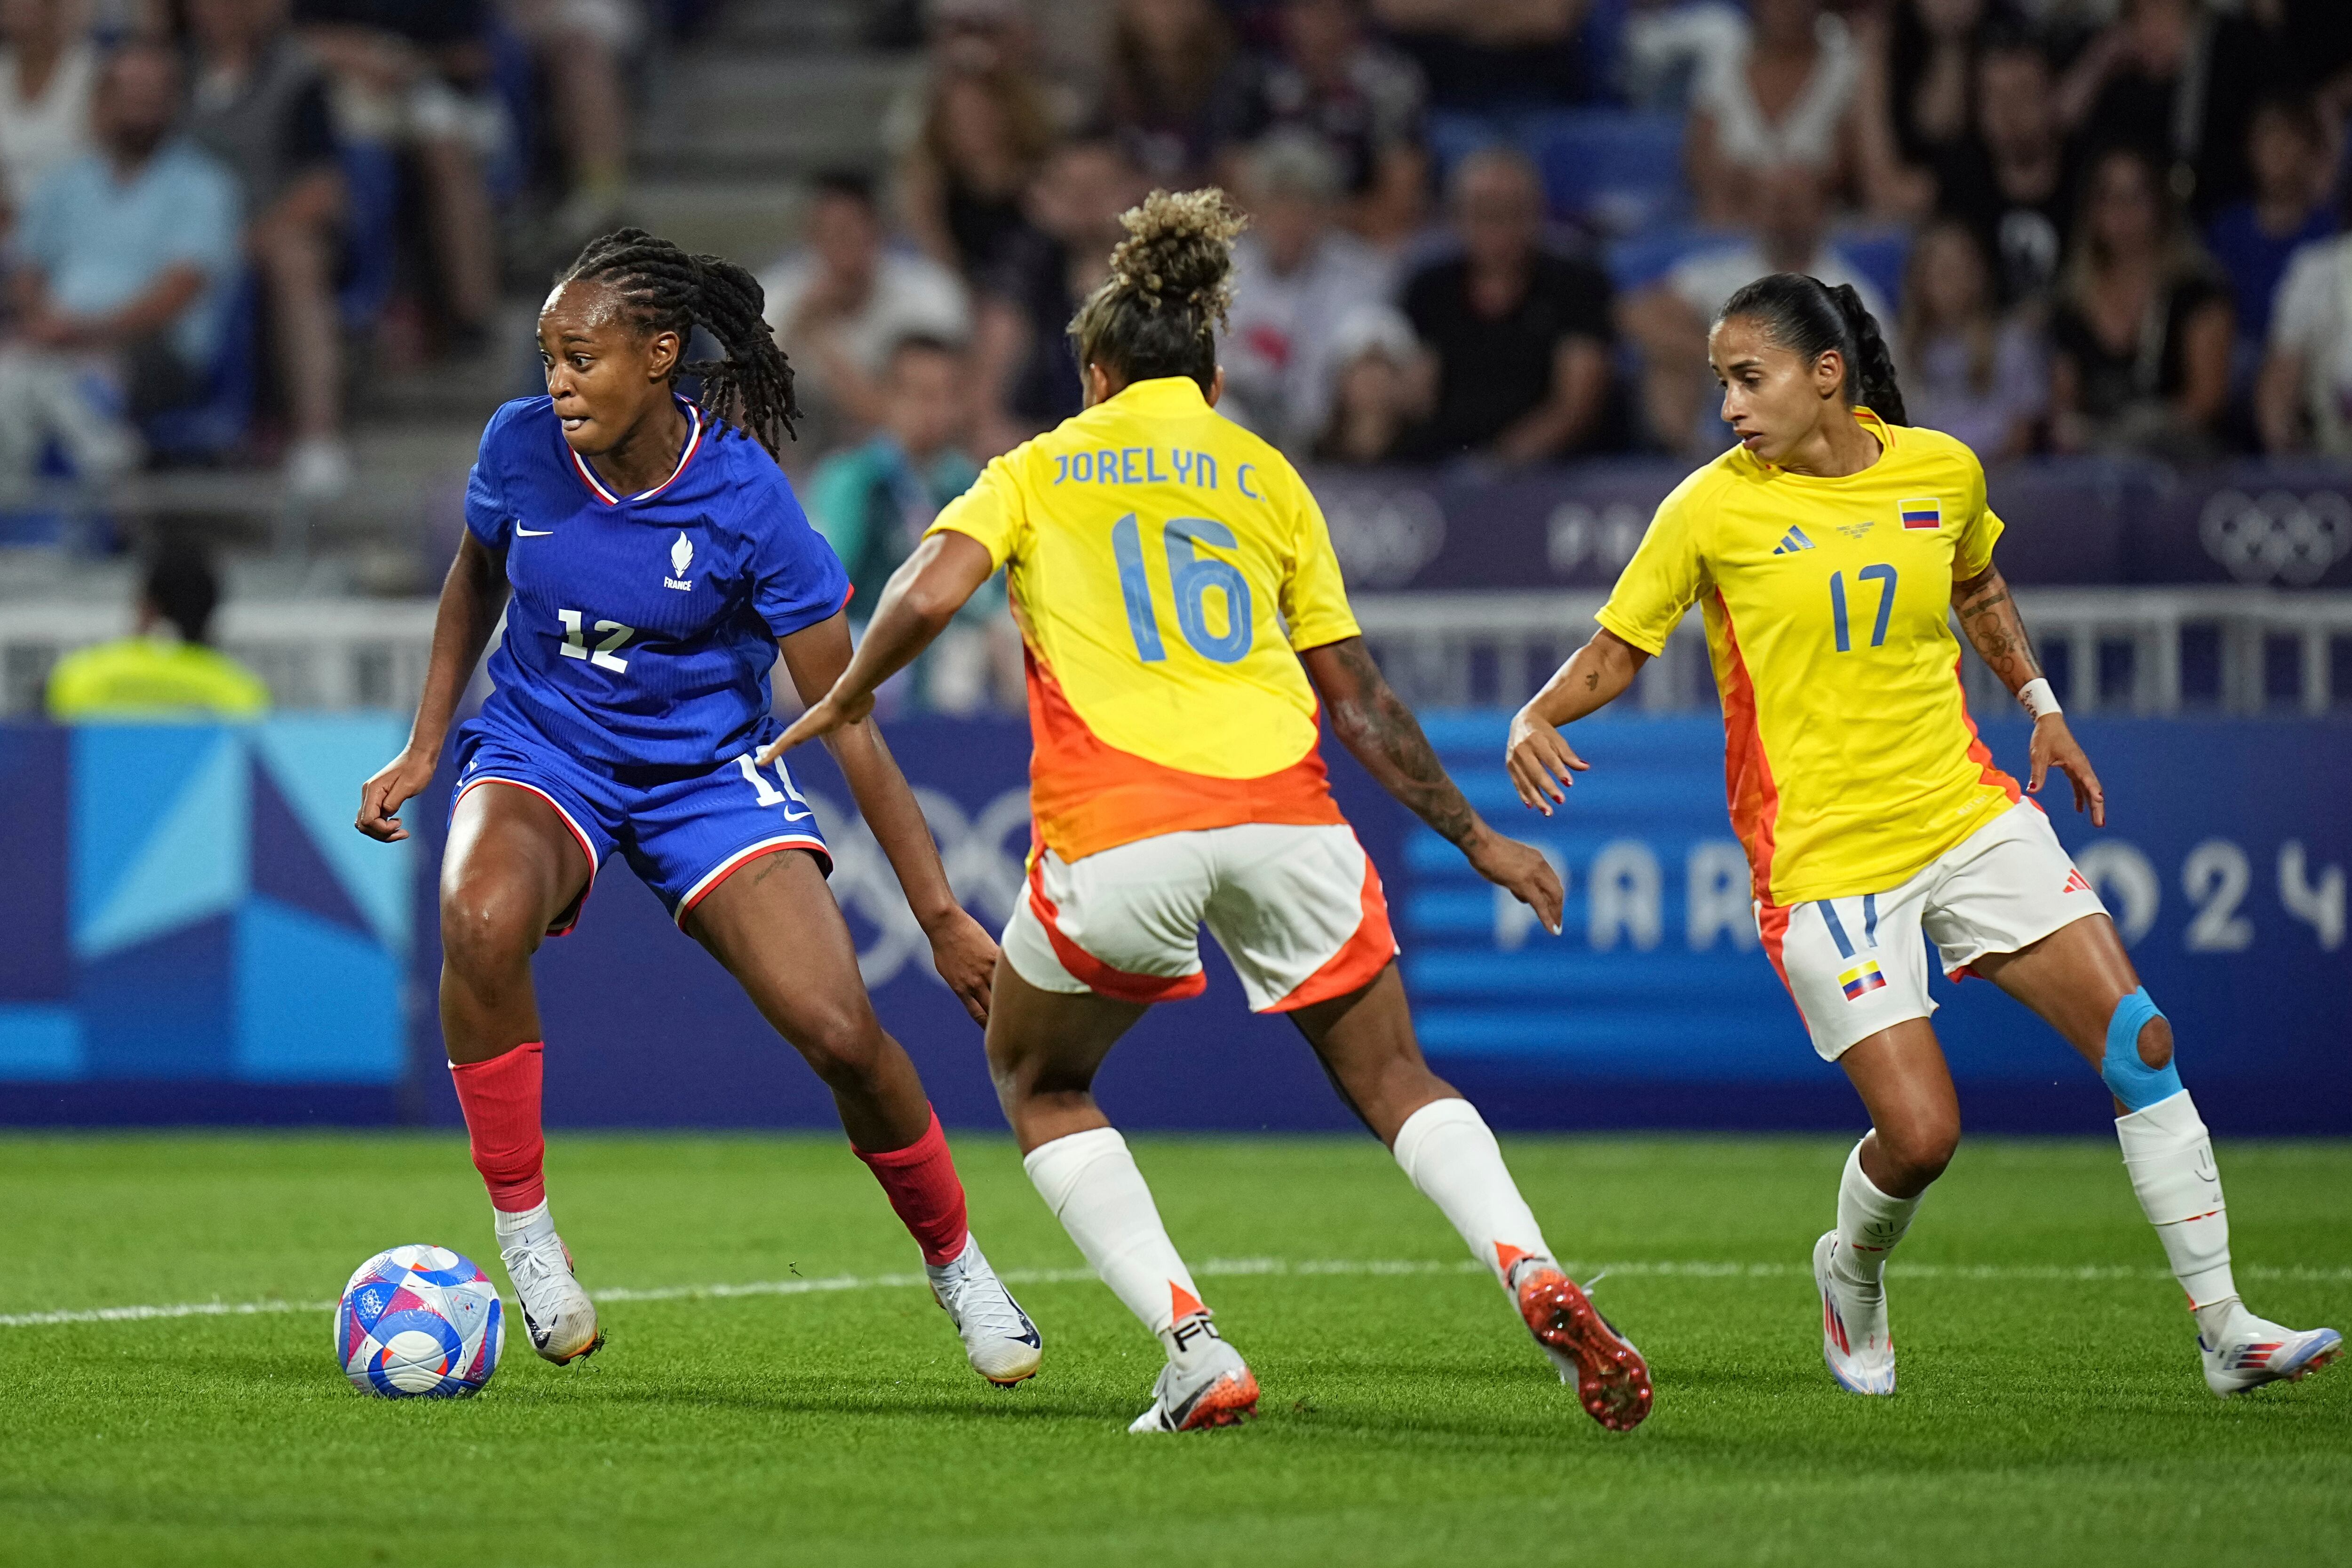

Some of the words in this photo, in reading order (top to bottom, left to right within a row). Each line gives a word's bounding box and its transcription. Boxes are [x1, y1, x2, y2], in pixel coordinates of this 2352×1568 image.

[1053, 447, 1217, 489] JORELYN
[1238, 463, 1266, 502] C.
[663, 576, 692, 591] FRANCE
[1111, 511, 1253, 664] 16
[1829, 563, 1898, 652] 17
[558, 608, 636, 674] 12
